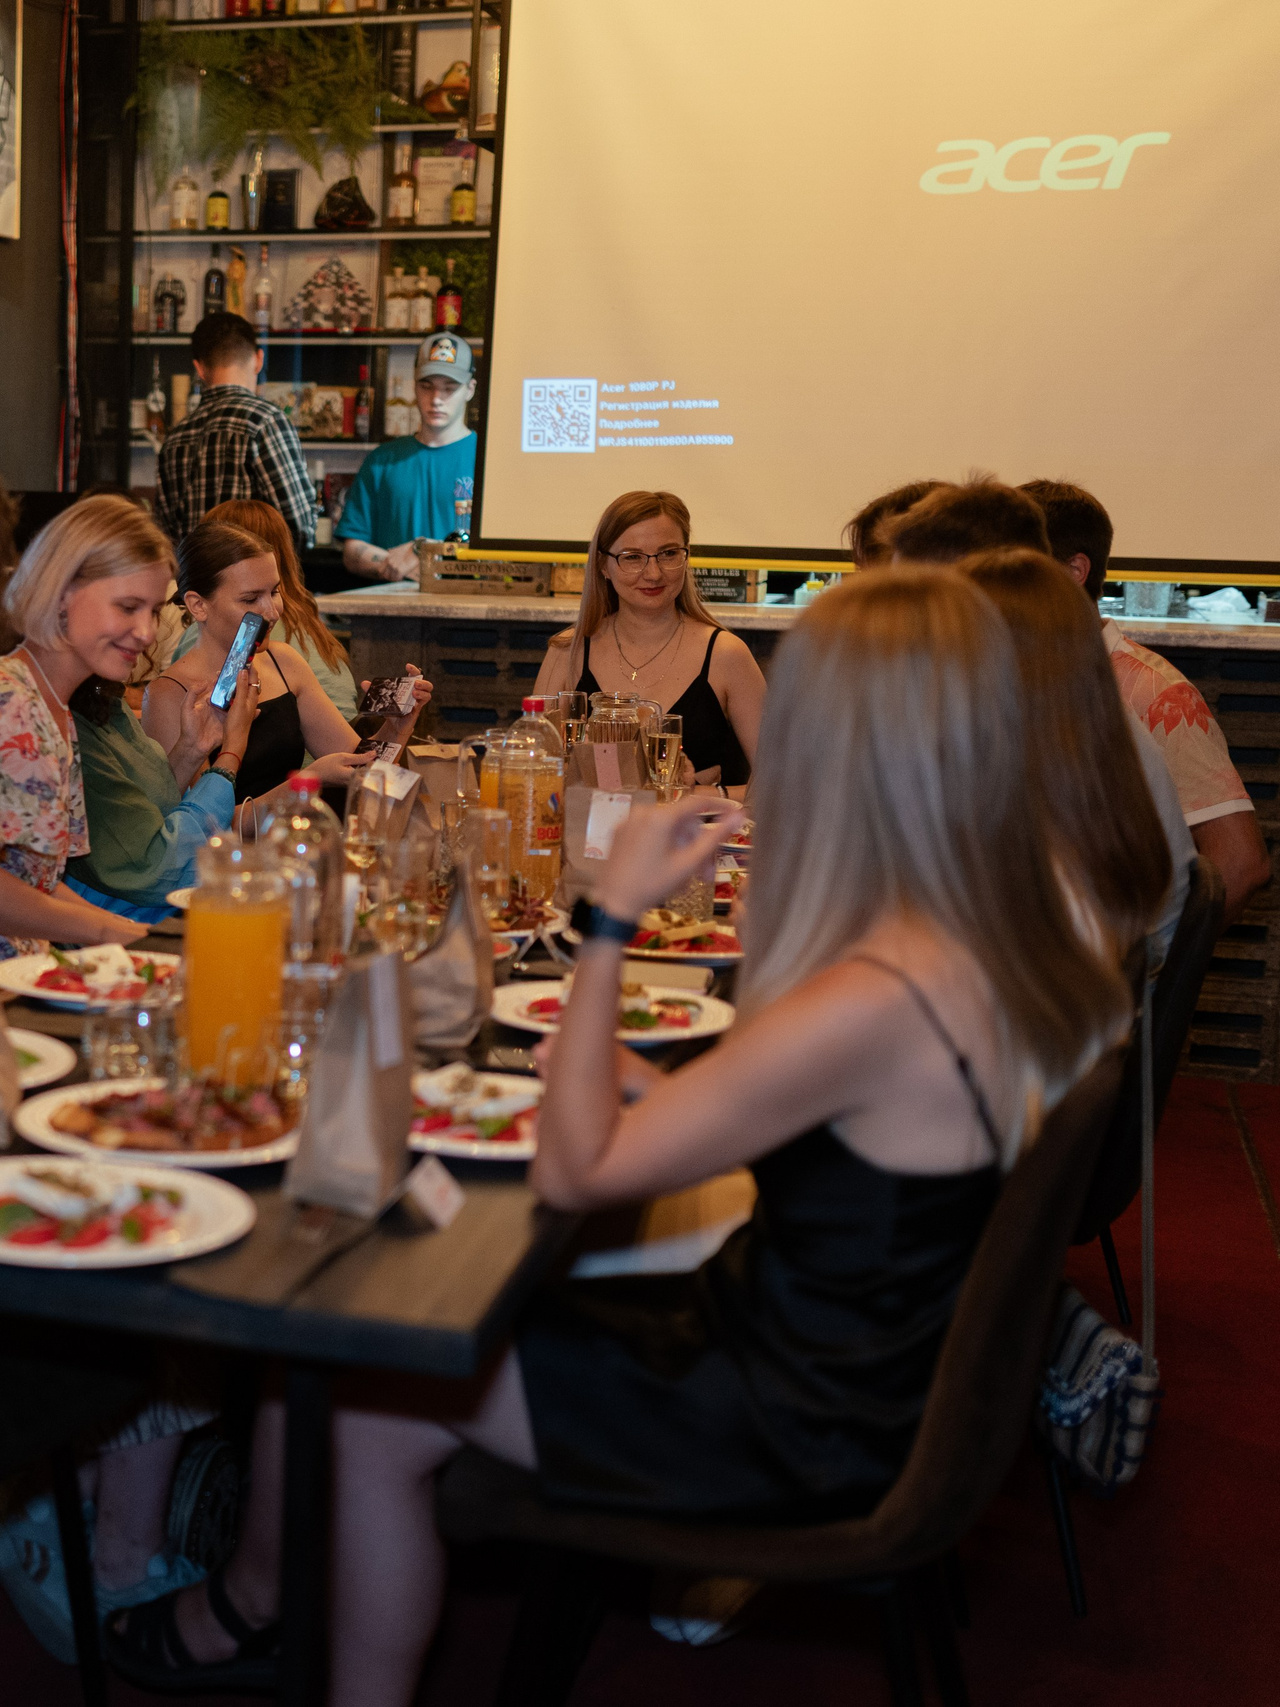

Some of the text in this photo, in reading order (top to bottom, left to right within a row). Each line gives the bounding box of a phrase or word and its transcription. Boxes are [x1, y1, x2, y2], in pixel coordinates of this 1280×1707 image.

[919, 131, 1171, 195] acer
[601, 380, 675, 393] Acer 1080P PJ
[600, 399, 719, 412] Регистрация изделия
[599, 418, 660, 430] Подробнее
[444, 562, 493, 574] GARDEN
[711, 568, 740, 577] RULES
